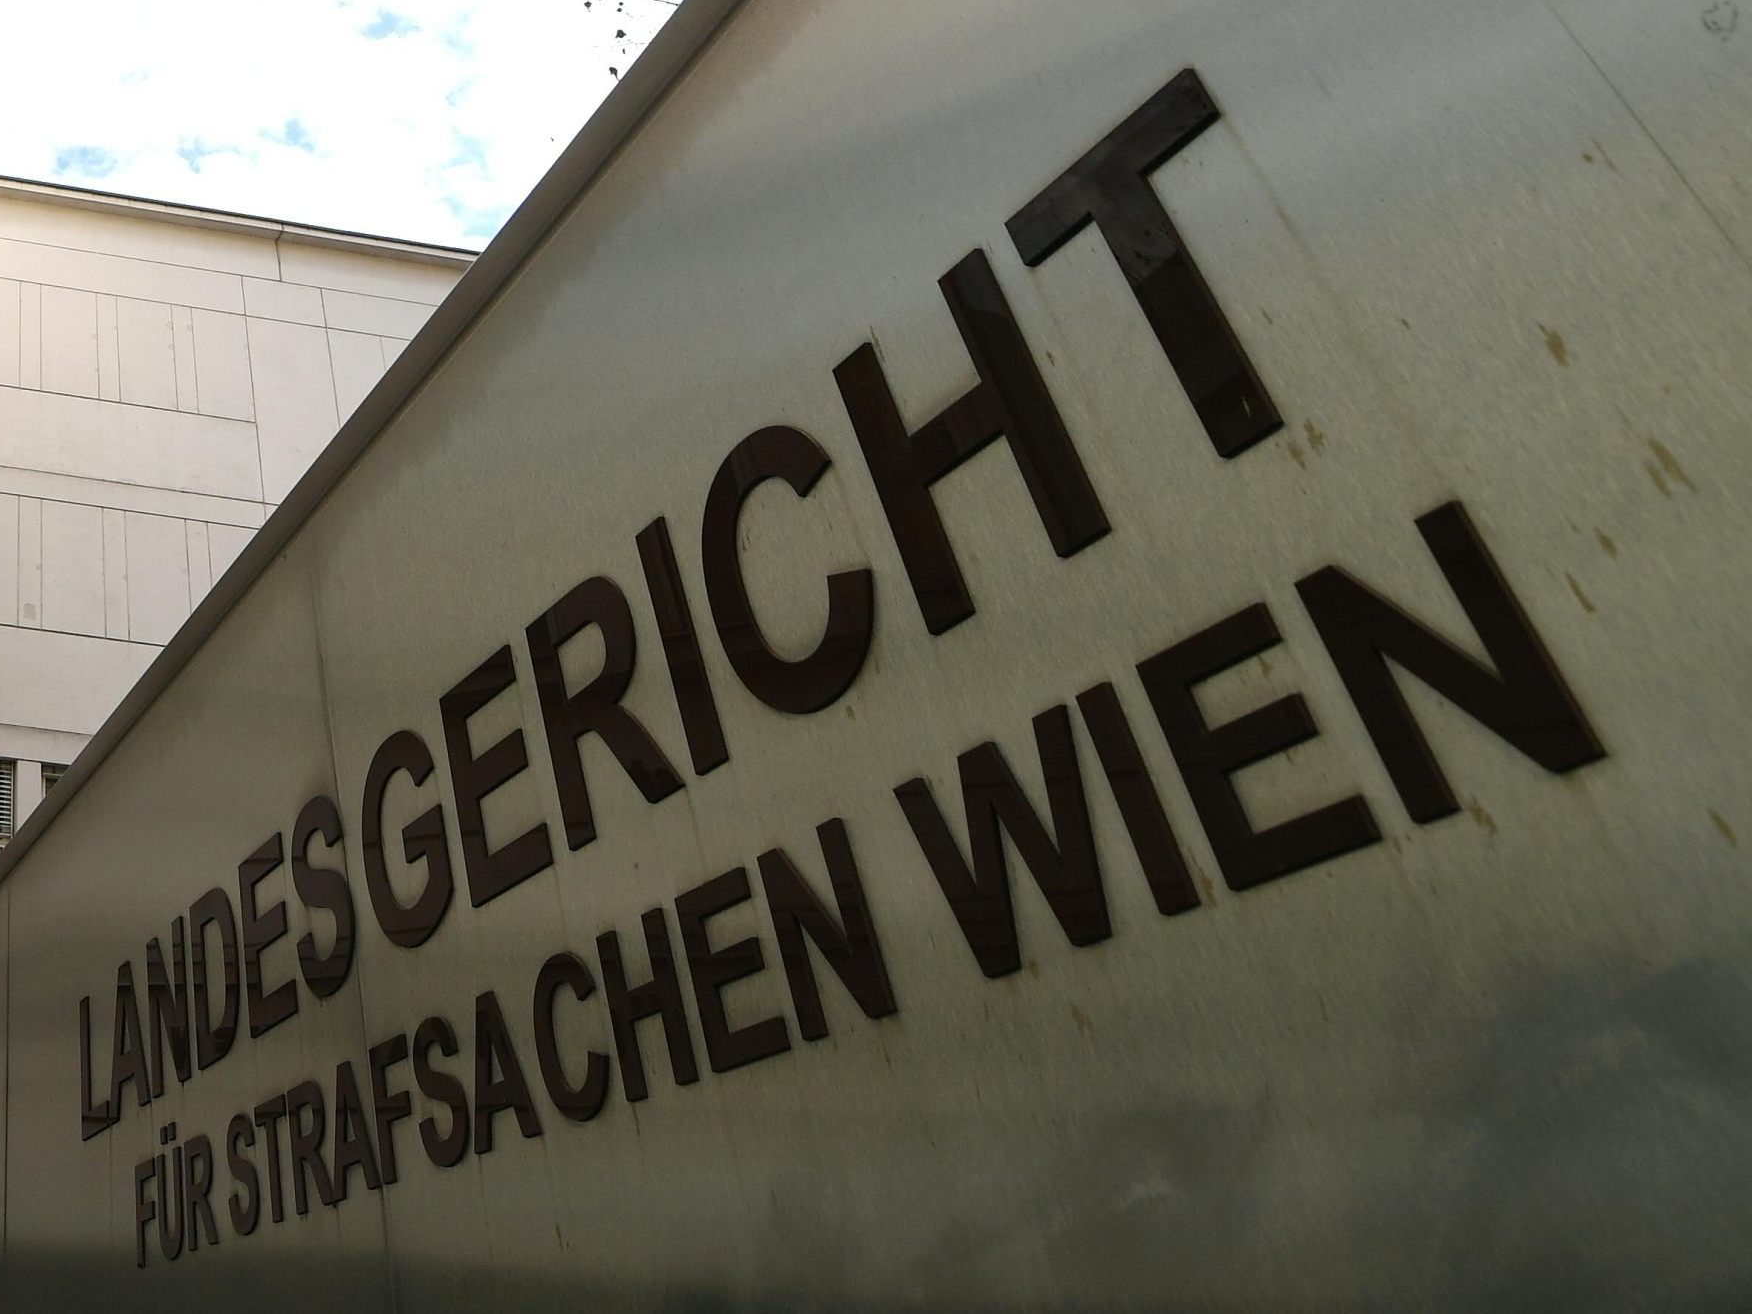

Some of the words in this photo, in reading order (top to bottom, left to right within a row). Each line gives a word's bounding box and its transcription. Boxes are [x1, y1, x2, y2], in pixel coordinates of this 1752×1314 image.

[79, 68, 1284, 1143] LANDESGERICHT
[134, 1121, 220, 1269] FÜR
[226, 817, 898, 1236] STRAFSACHEN
[893, 499, 1607, 979] WIEN
